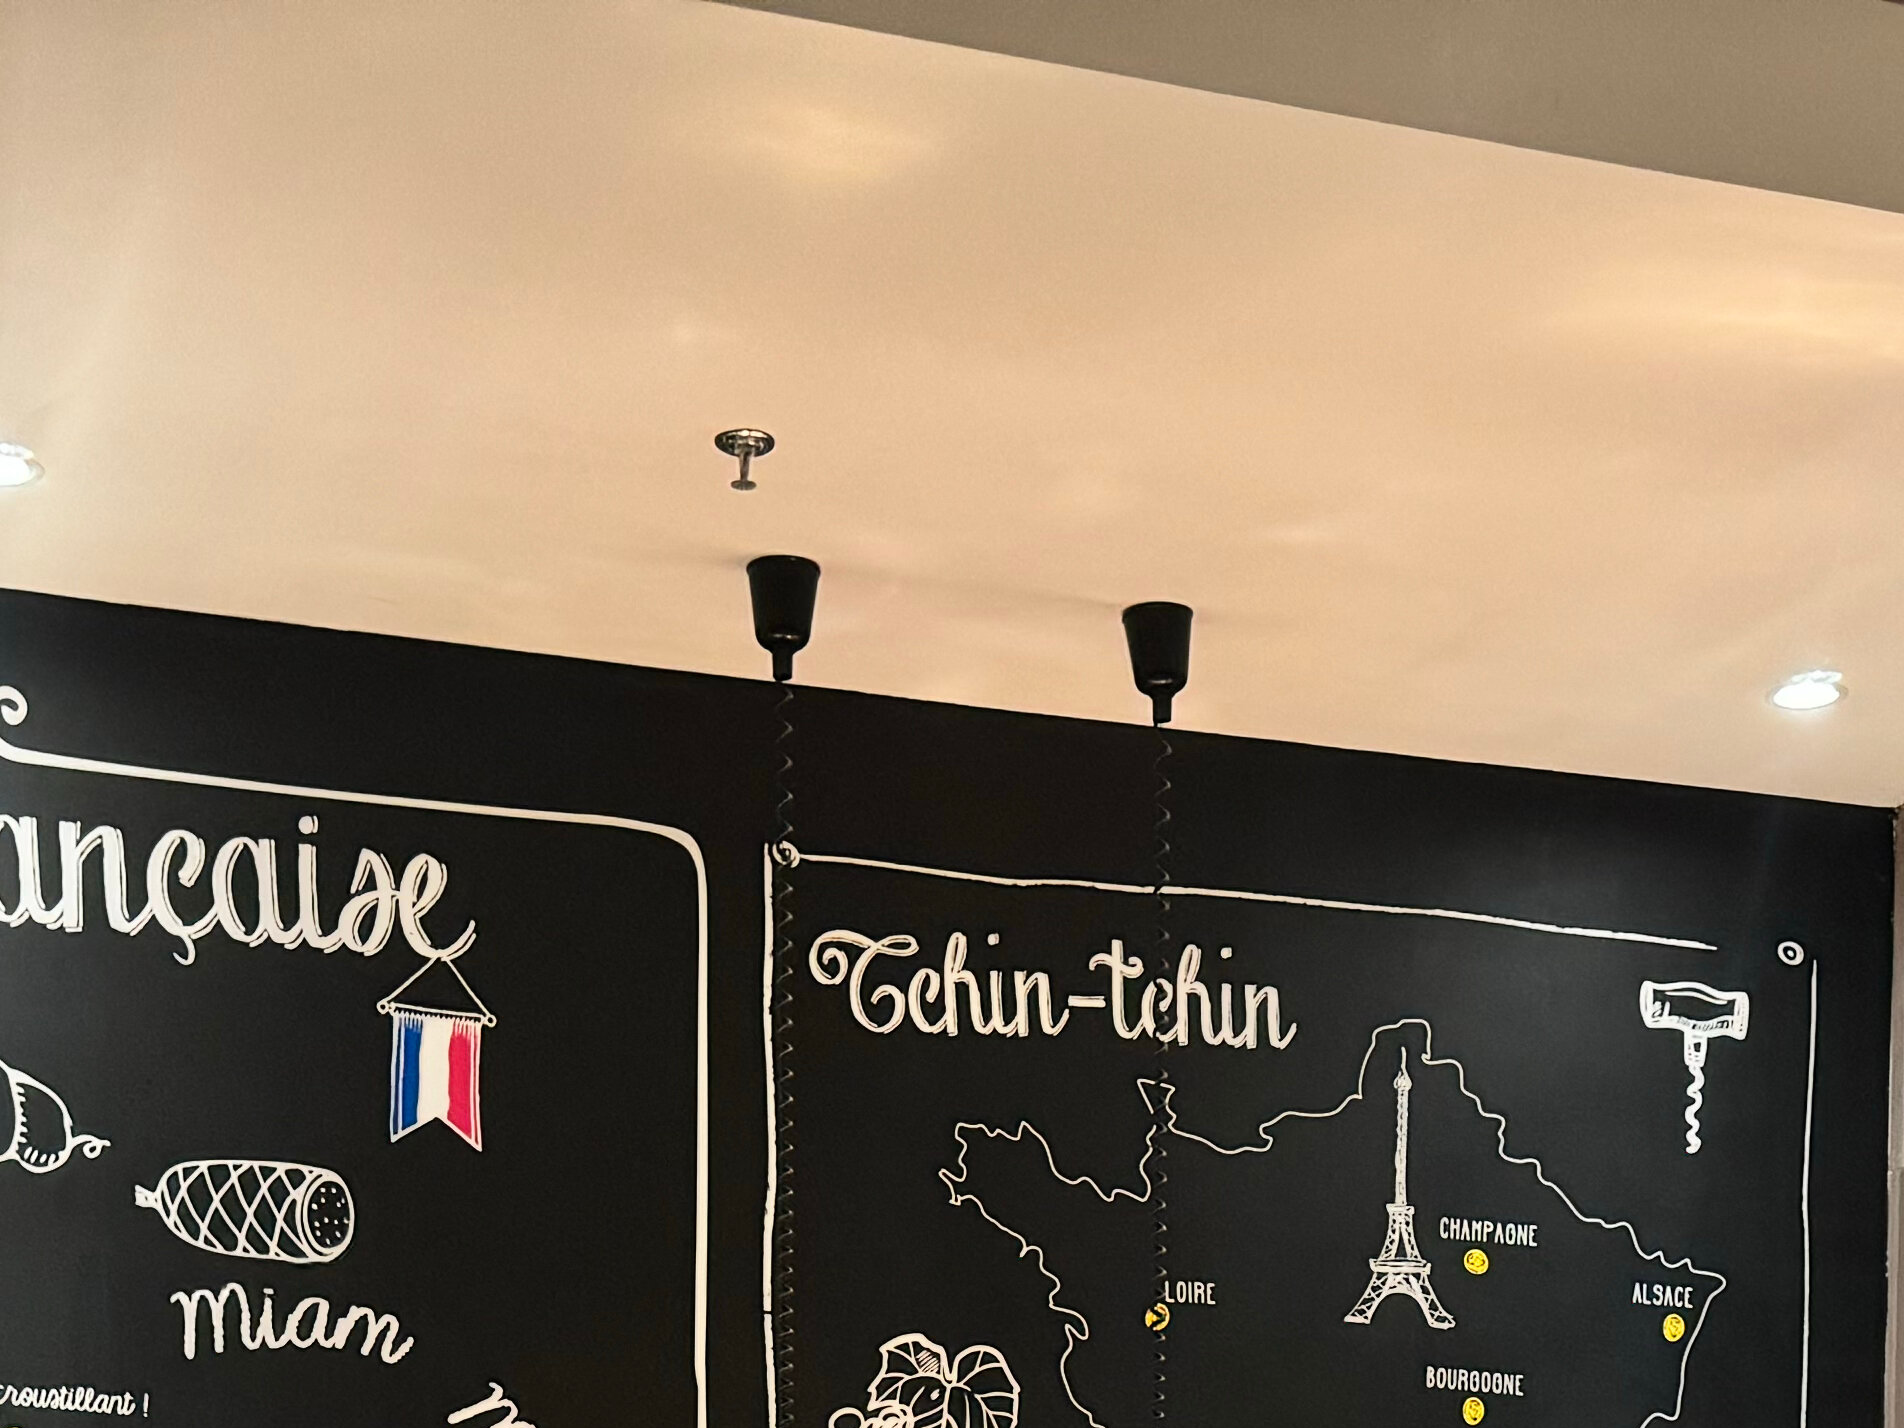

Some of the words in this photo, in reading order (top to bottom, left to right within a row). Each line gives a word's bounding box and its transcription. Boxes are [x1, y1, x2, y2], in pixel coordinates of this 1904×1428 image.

[808, 929, 1297, 1050] Tchin-tchin
[1439, 1217, 1538, 1247] CHAMPAGNE
[1164, 1280, 1217, 1306] LOIRE
[1632, 1282, 1694, 1309] ALSACE
[170, 1281, 415, 1365] Miam
[1425, 1366, 1525, 1397] BOURGOGNE
